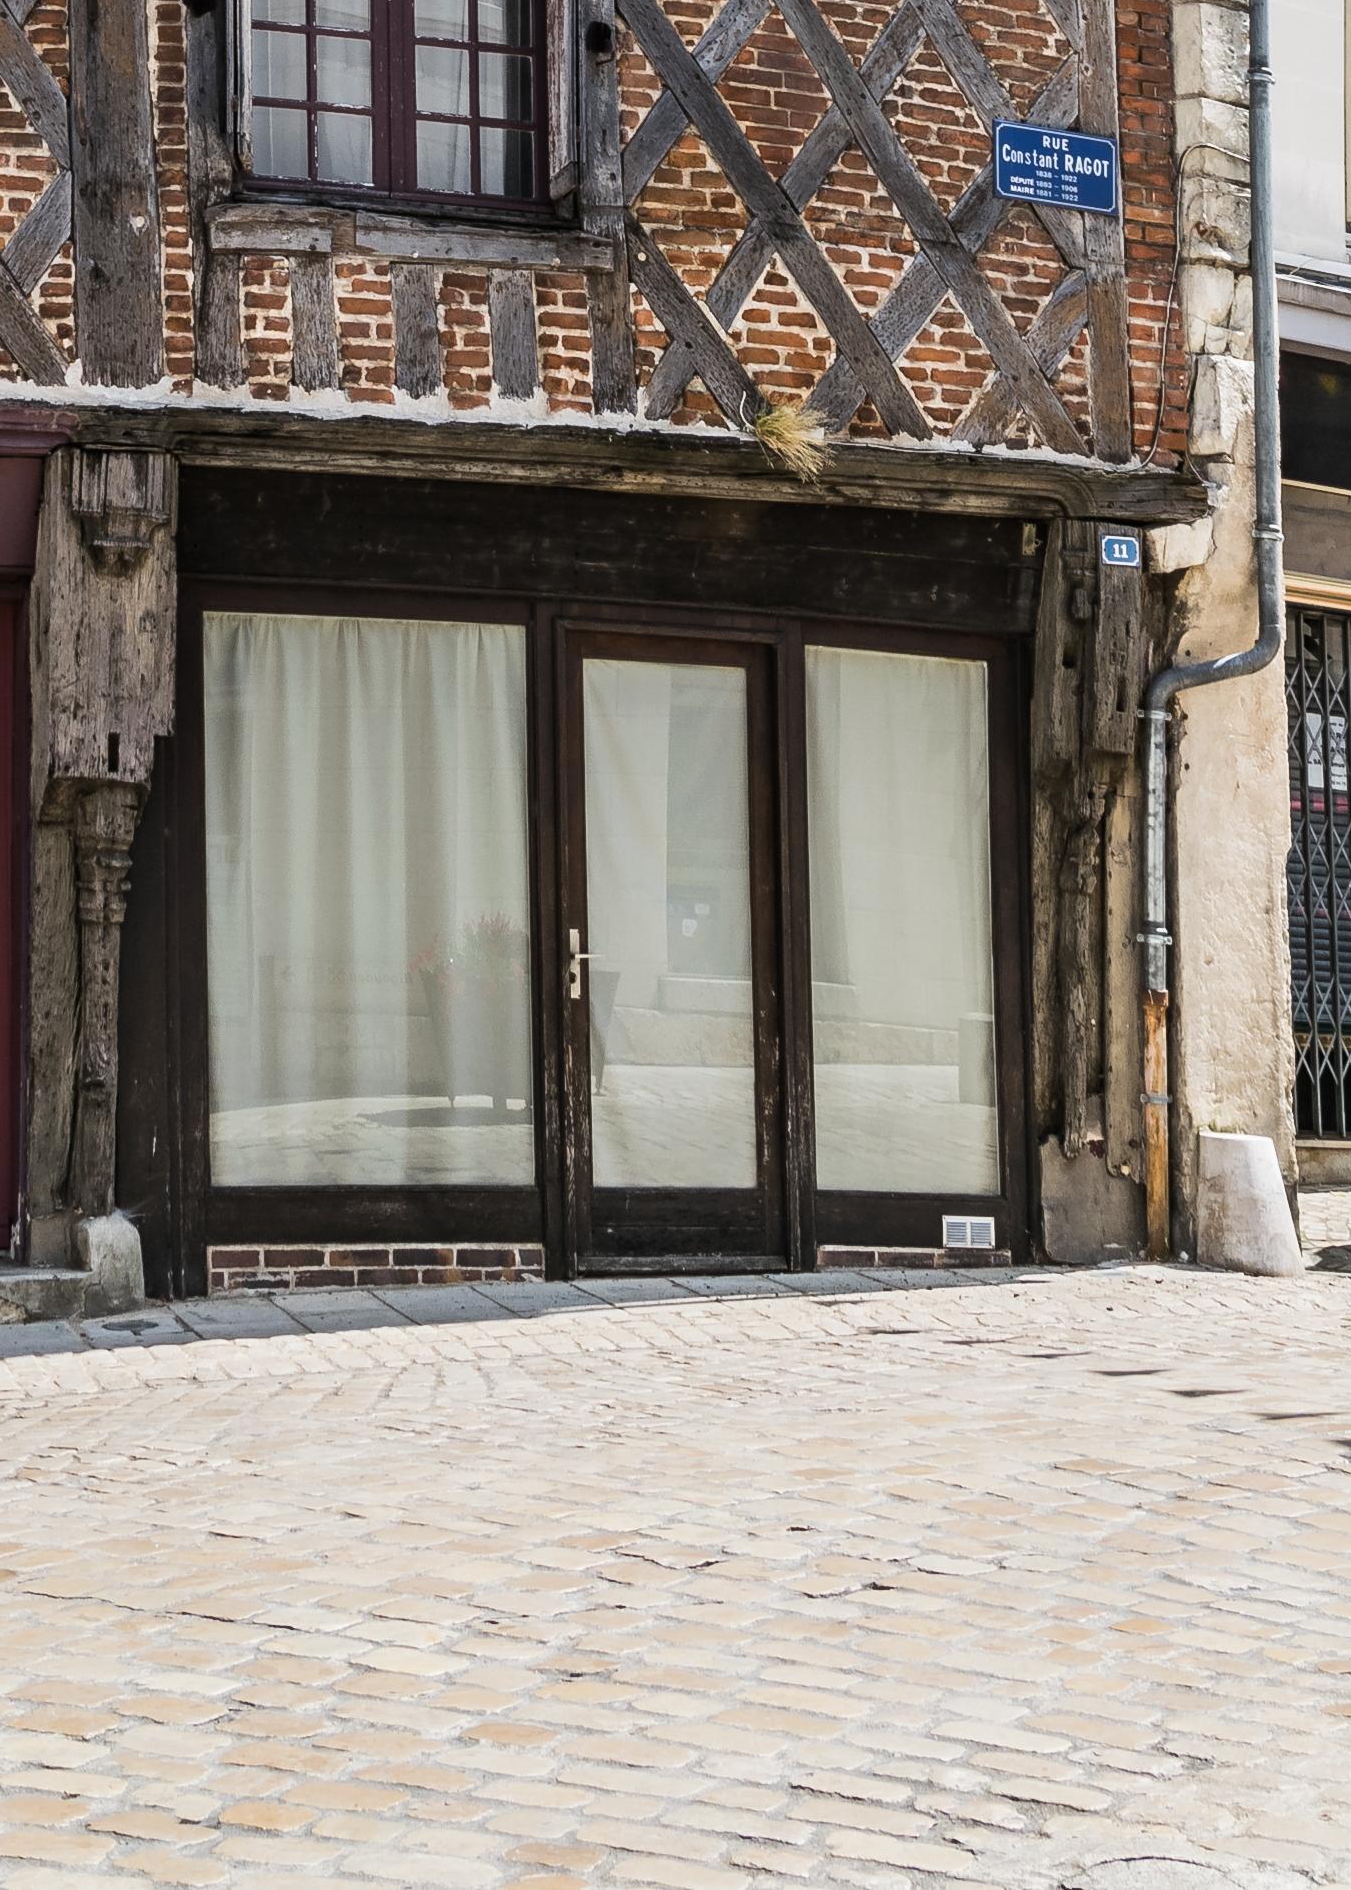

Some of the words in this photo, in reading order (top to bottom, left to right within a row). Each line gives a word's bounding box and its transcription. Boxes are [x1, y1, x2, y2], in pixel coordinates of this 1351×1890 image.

[1042, 135, 1069, 151] RUE
[1002, 144, 1059, 170] Constant
[1065, 154, 1109, 178] RAGOT
[1010, 185, 1034, 195] MAIRE
[1113, 544, 1128, 559] 11
